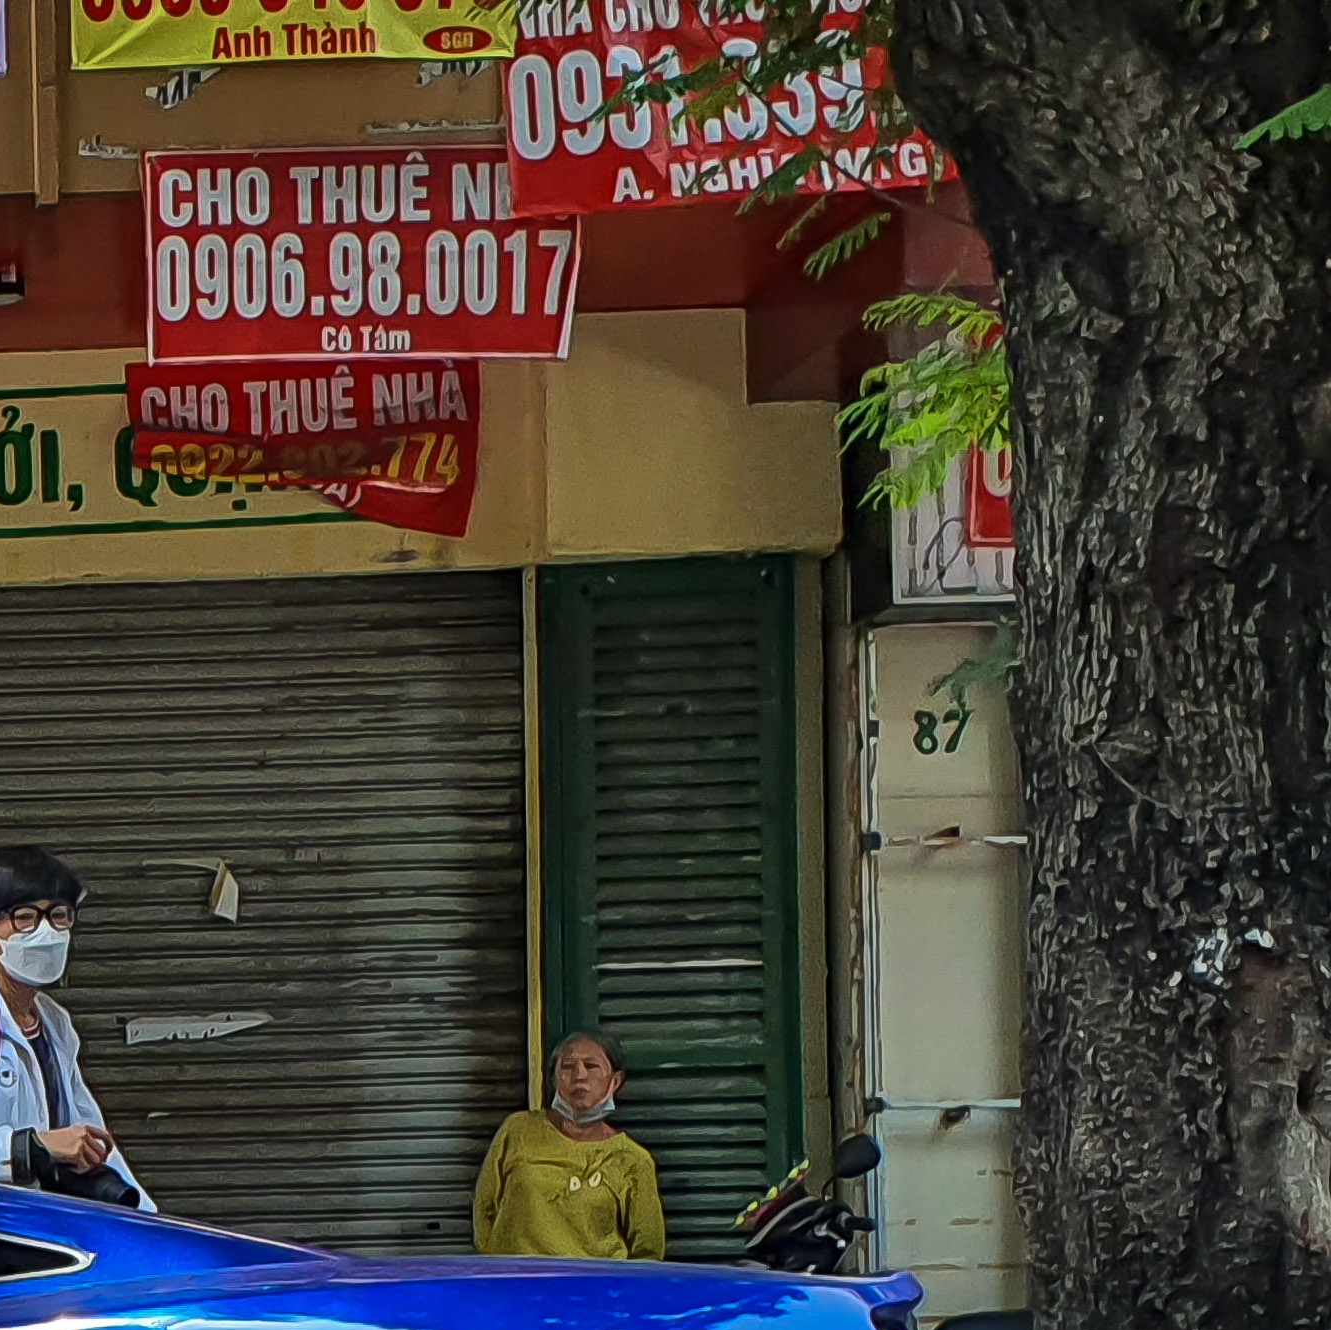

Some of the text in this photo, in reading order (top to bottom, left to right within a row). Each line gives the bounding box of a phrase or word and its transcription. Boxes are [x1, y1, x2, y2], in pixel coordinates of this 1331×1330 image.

[211, 25, 273, 60] Anh
[280, 20, 377, 57] Thành
[159, 166, 271, 228] CHO
[288, 151, 432, 225] THUÊ
[613, 165, 656, 204] A.
[156, 229, 573, 323] 0906.98.0017
[321, 322, 412, 352] Cô Tâm
[140, 358, 469, 436] CHO THUÊ NHÀ
[912, 708, 976, 756] 87
